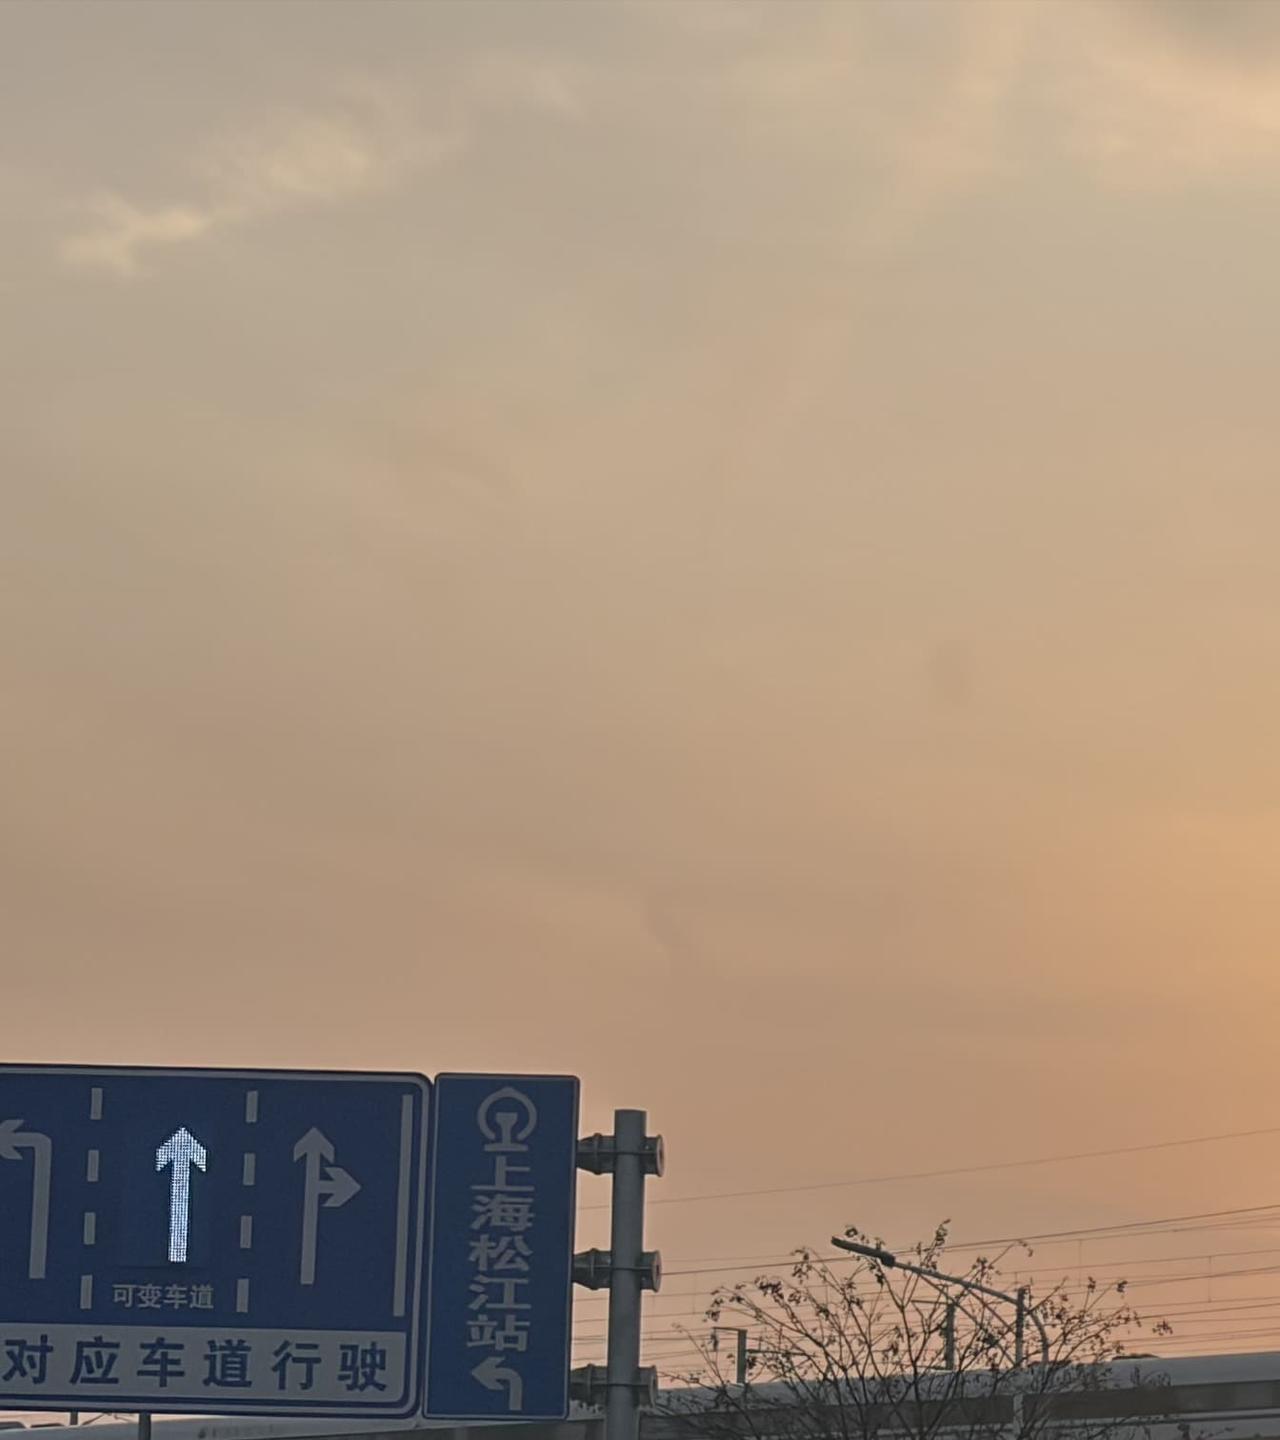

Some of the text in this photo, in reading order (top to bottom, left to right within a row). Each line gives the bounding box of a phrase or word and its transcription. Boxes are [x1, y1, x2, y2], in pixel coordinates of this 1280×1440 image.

[467, 1155, 535, 1351] 上海松江站
[112, 1284, 214, 1309] 可变车道
[2, 1334, 388, 1392] 对应车道行驶
